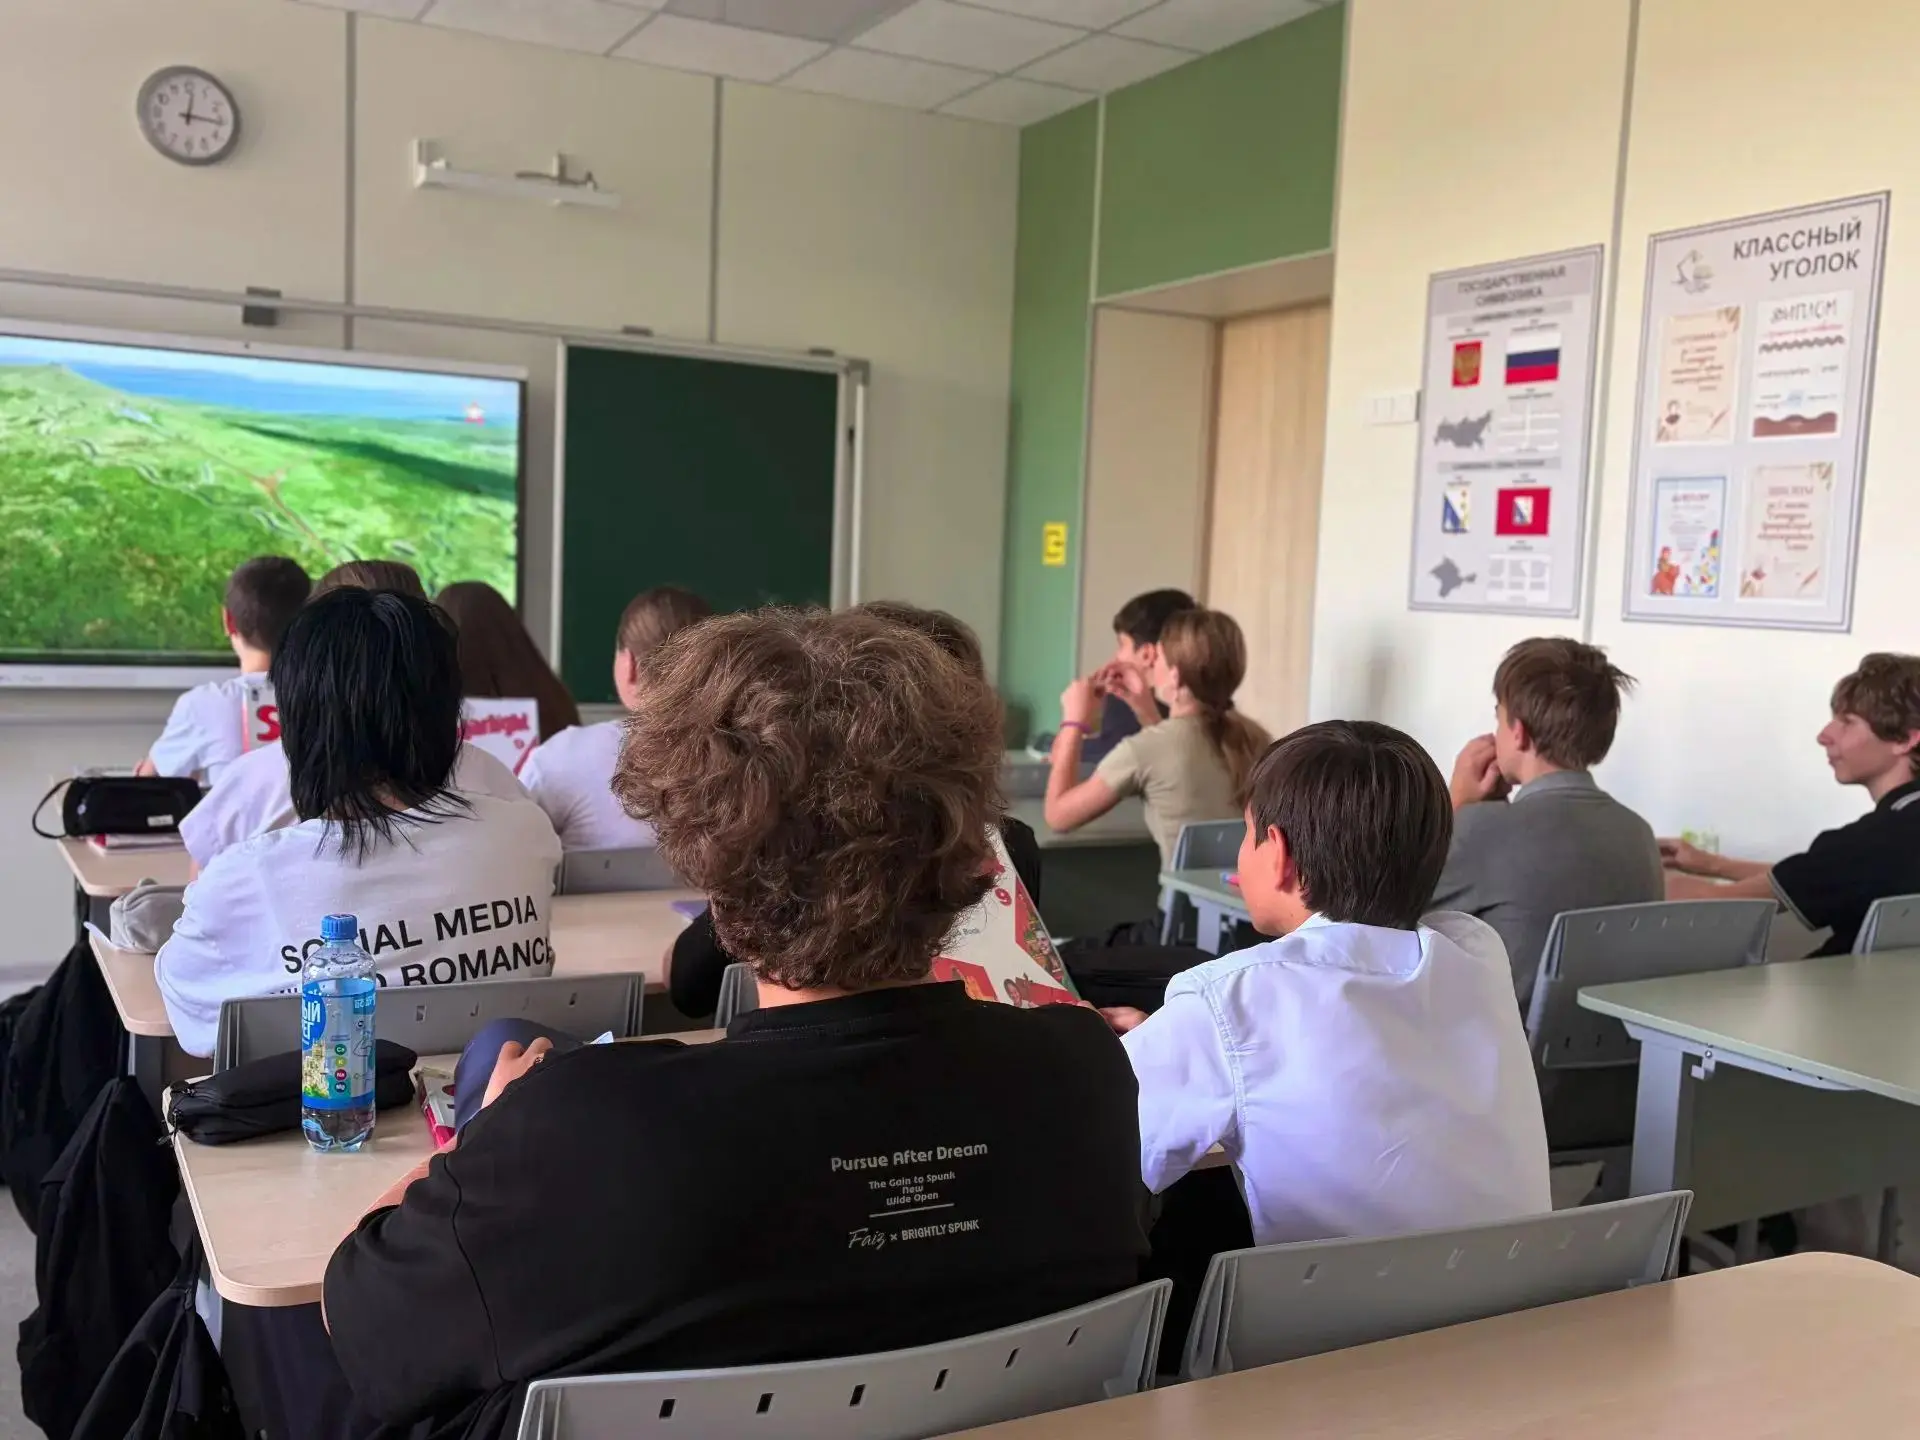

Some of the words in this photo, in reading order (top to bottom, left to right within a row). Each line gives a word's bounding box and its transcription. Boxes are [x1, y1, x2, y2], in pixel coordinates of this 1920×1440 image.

[1733, 216, 1862, 260] КЛАССНЫЙ
[1770, 249, 1860, 282] УГОЛОК
[434, 895, 538, 941] MEDIA
[831, 1155, 889, 1172] Pursue
[893, 1149, 932, 1165] After
[936, 1143, 988, 1160] Dream
[868, 1180, 886, 1189] The
[914, 1175, 924, 1184] to
[927, 1171, 956, 1183] Spunk
[886, 1195, 911, 1205] Wide
[914, 1192, 938, 1201] Open
[902, 1223, 947, 1241] BRIGHTLY
[948, 1219, 980, 1234] SPUNK
